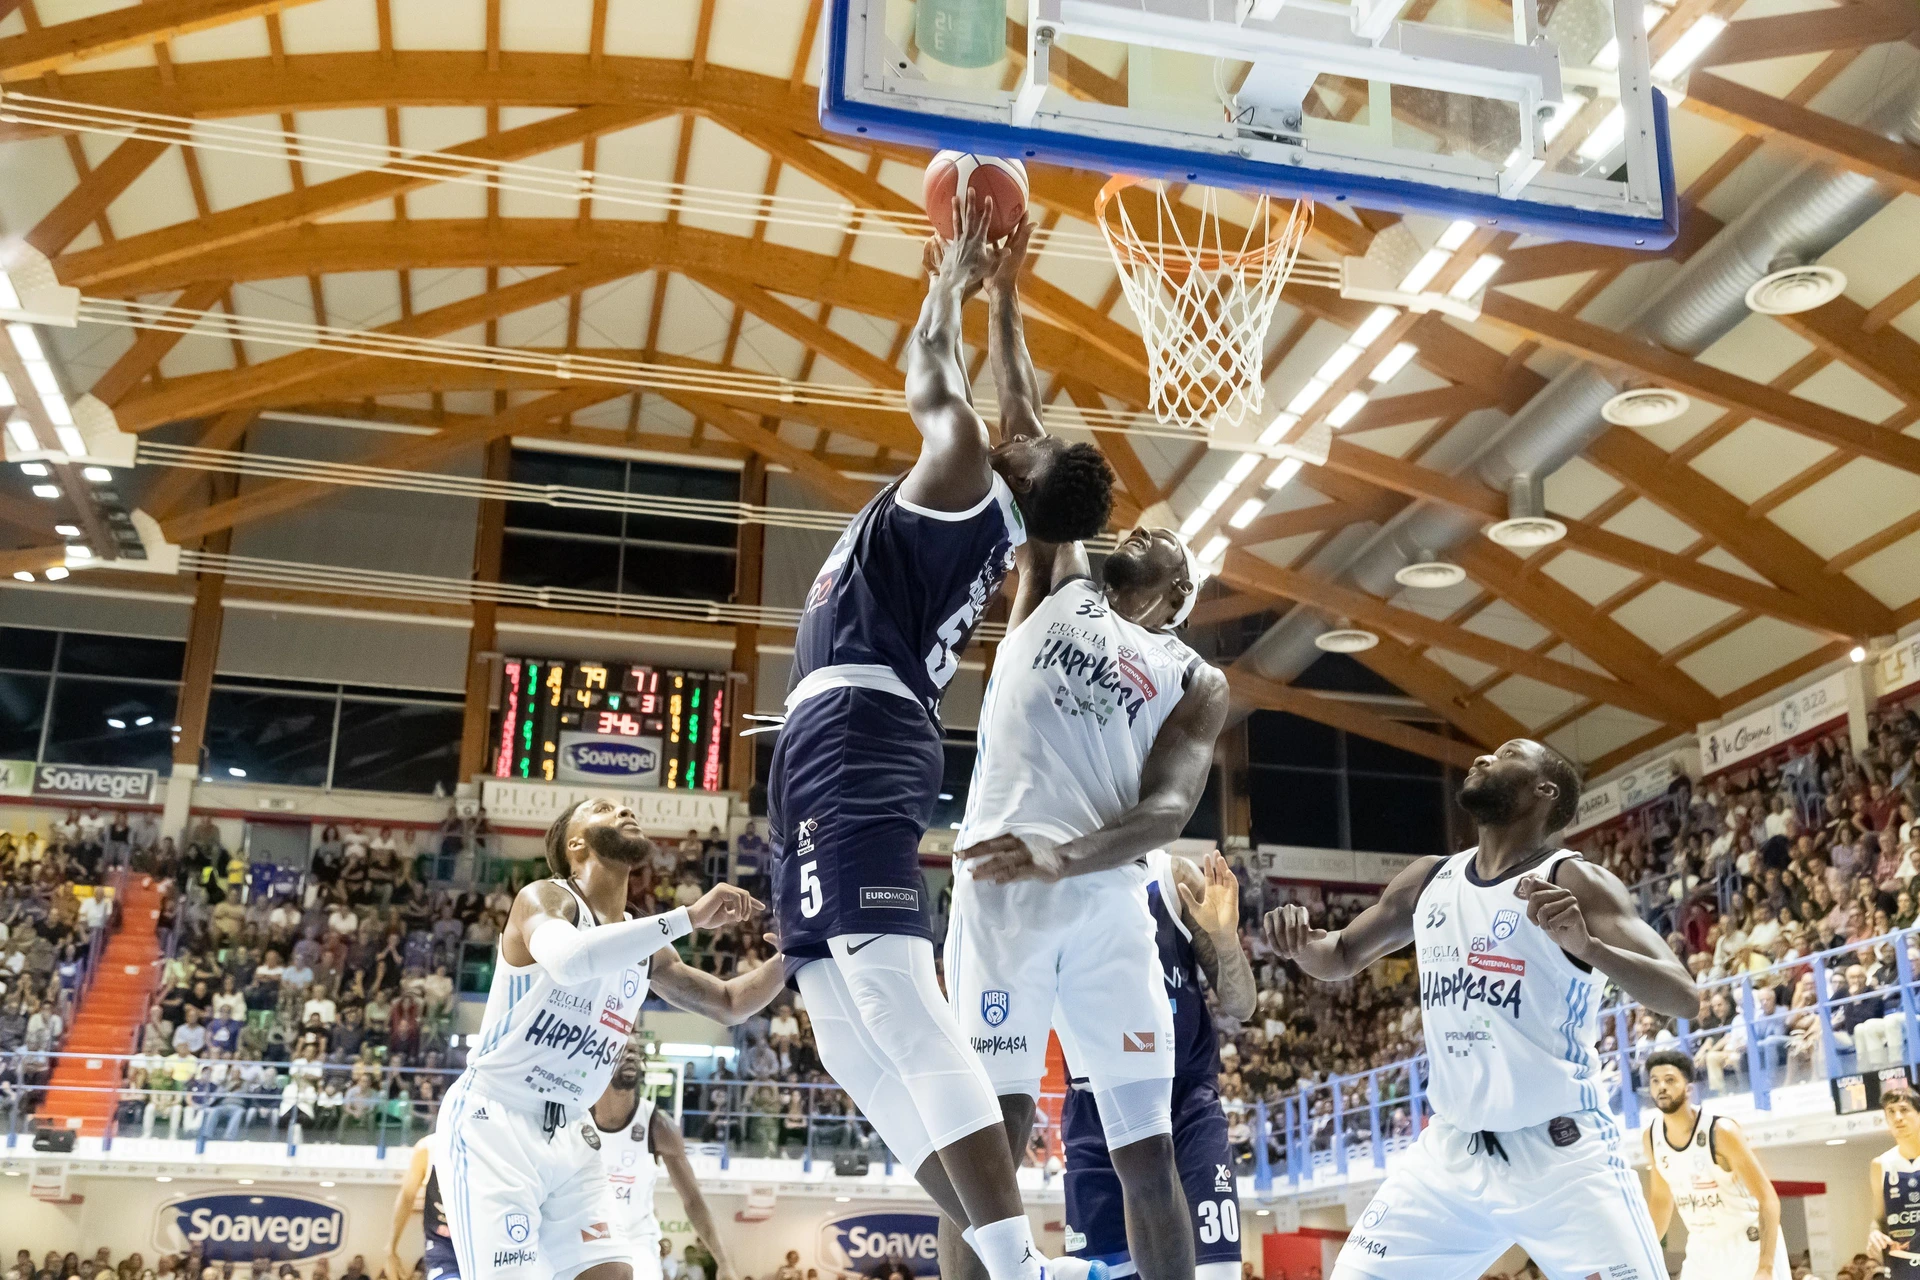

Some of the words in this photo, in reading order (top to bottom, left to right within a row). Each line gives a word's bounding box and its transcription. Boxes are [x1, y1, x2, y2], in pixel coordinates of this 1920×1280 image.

[1076, 600, 1107, 618] 33
[1050, 622, 1106, 647] PUGLIA
[581, 666, 607, 689] 79
[631, 671, 658, 693] 71
[1119, 663, 1144, 685] NTENNA
[577, 690, 591, 708] 4
[609, 695, 620, 710] 4
[641, 694, 655, 713] 3
[578, 749, 655, 774] Soavegel
[39, 766, 149, 798] Soavegel
[800, 860, 823, 918] 5
[865, 892, 915, 902] EUROMODA
[1426, 902, 1451, 929] 35
[1422, 945, 1459, 957] PUGLIA
[1471, 937, 1486, 952] 85
[1478, 960, 1510, 968] ANTENNA
[1511, 964, 1523, 972] SUD
[549, 989, 593, 1012] PUGLIA
[605, 995, 617, 1011] 85
[984, 992, 1007, 1009] NBB
[1422, 967, 1522, 1019] HAPPYCASA
[525, 1009, 624, 1076] HAPPYCASA
[188, 1208, 341, 1252] Soavegel
[1197, 1198, 1240, 1244] 30
